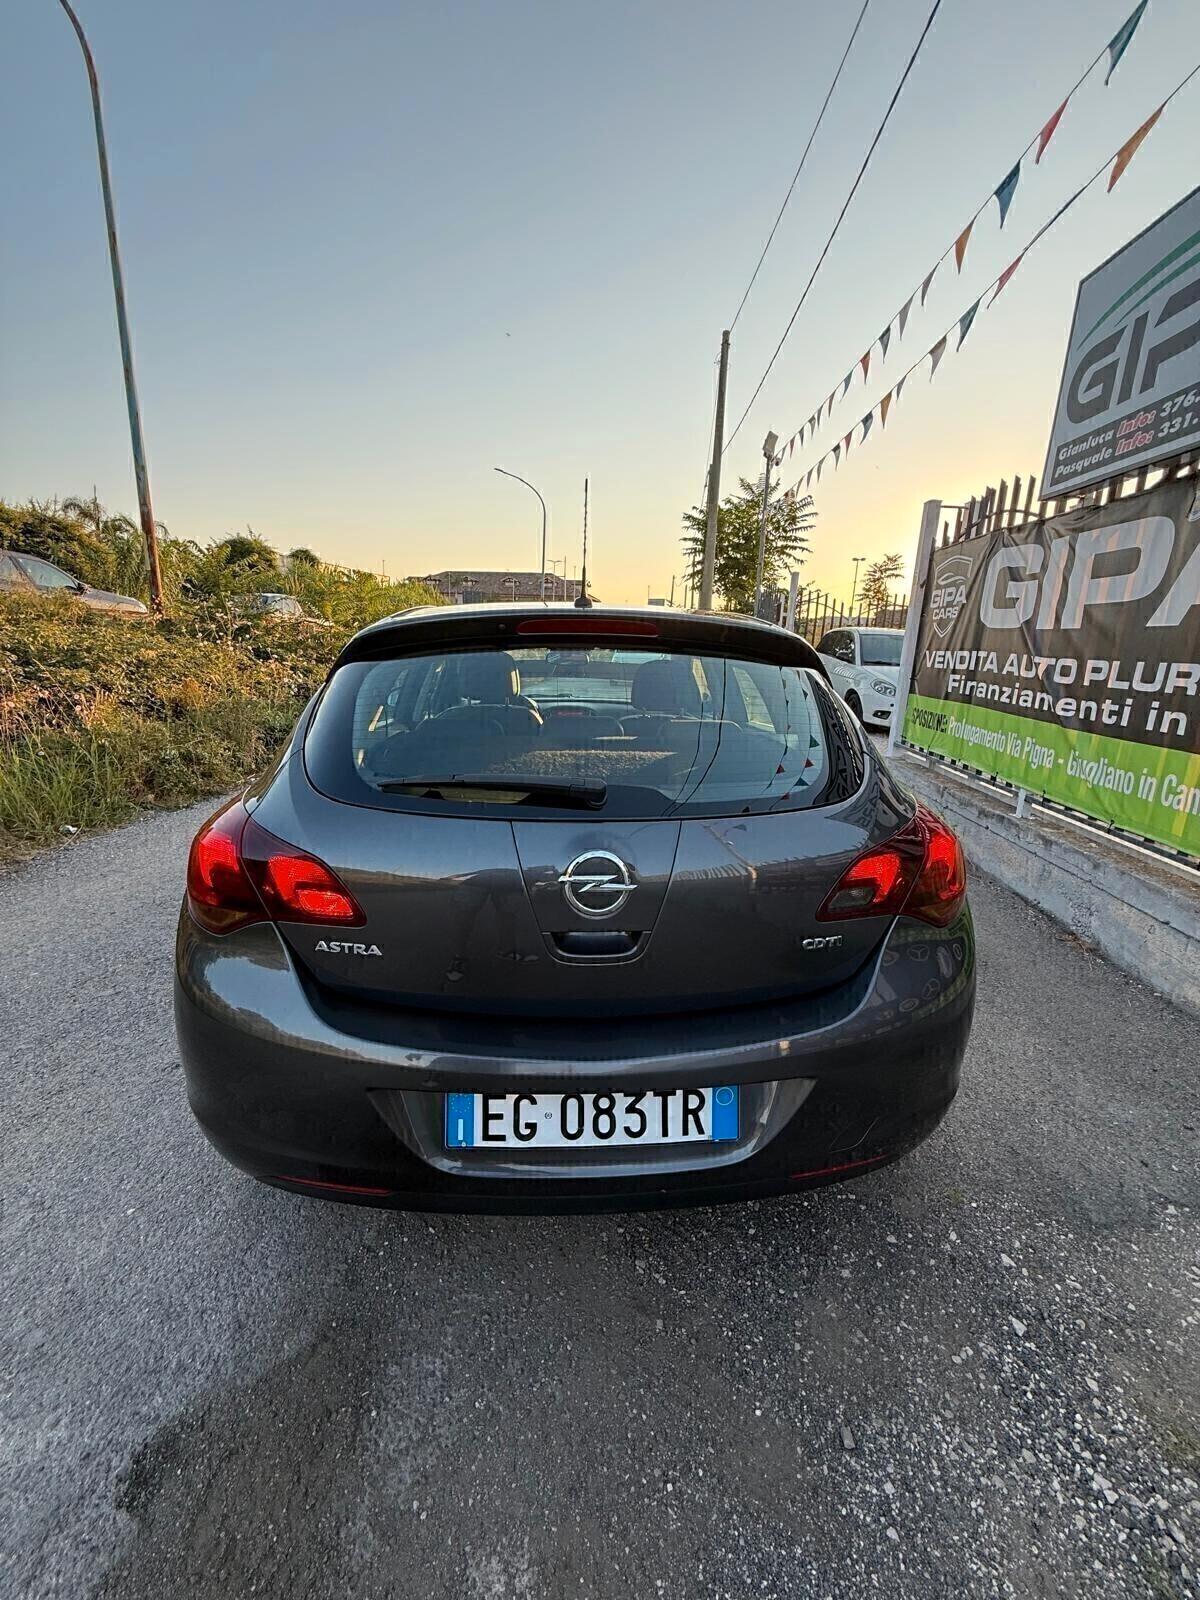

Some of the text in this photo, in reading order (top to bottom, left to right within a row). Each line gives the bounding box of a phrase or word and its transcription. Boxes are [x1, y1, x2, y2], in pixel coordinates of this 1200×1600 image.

[1054, 447, 1113, 478] Pasquale
[1114, 430, 1155, 456] Info:
[1058, 429, 1115, 460] Gianluca
[1116, 409, 1157, 438] Info:
[930, 584, 967, 609] GIPA
[932, 606, 959, 620] CARS
[925, 650, 1200, 696] VENDITA AUTO PLUR
[947, 674, 1188, 736] Finanziamenti in
[948, 716, 1006, 753] Prolungamento
[1007, 731, 1022, 757] Via
[1022, 736, 1056, 769] Pigna
[1137, 768, 1158, 802] in
[314, 940, 383, 956] ASTRA
[482, 1093, 538, 1142] EG
[560, 1088, 707, 1141] 083TR
